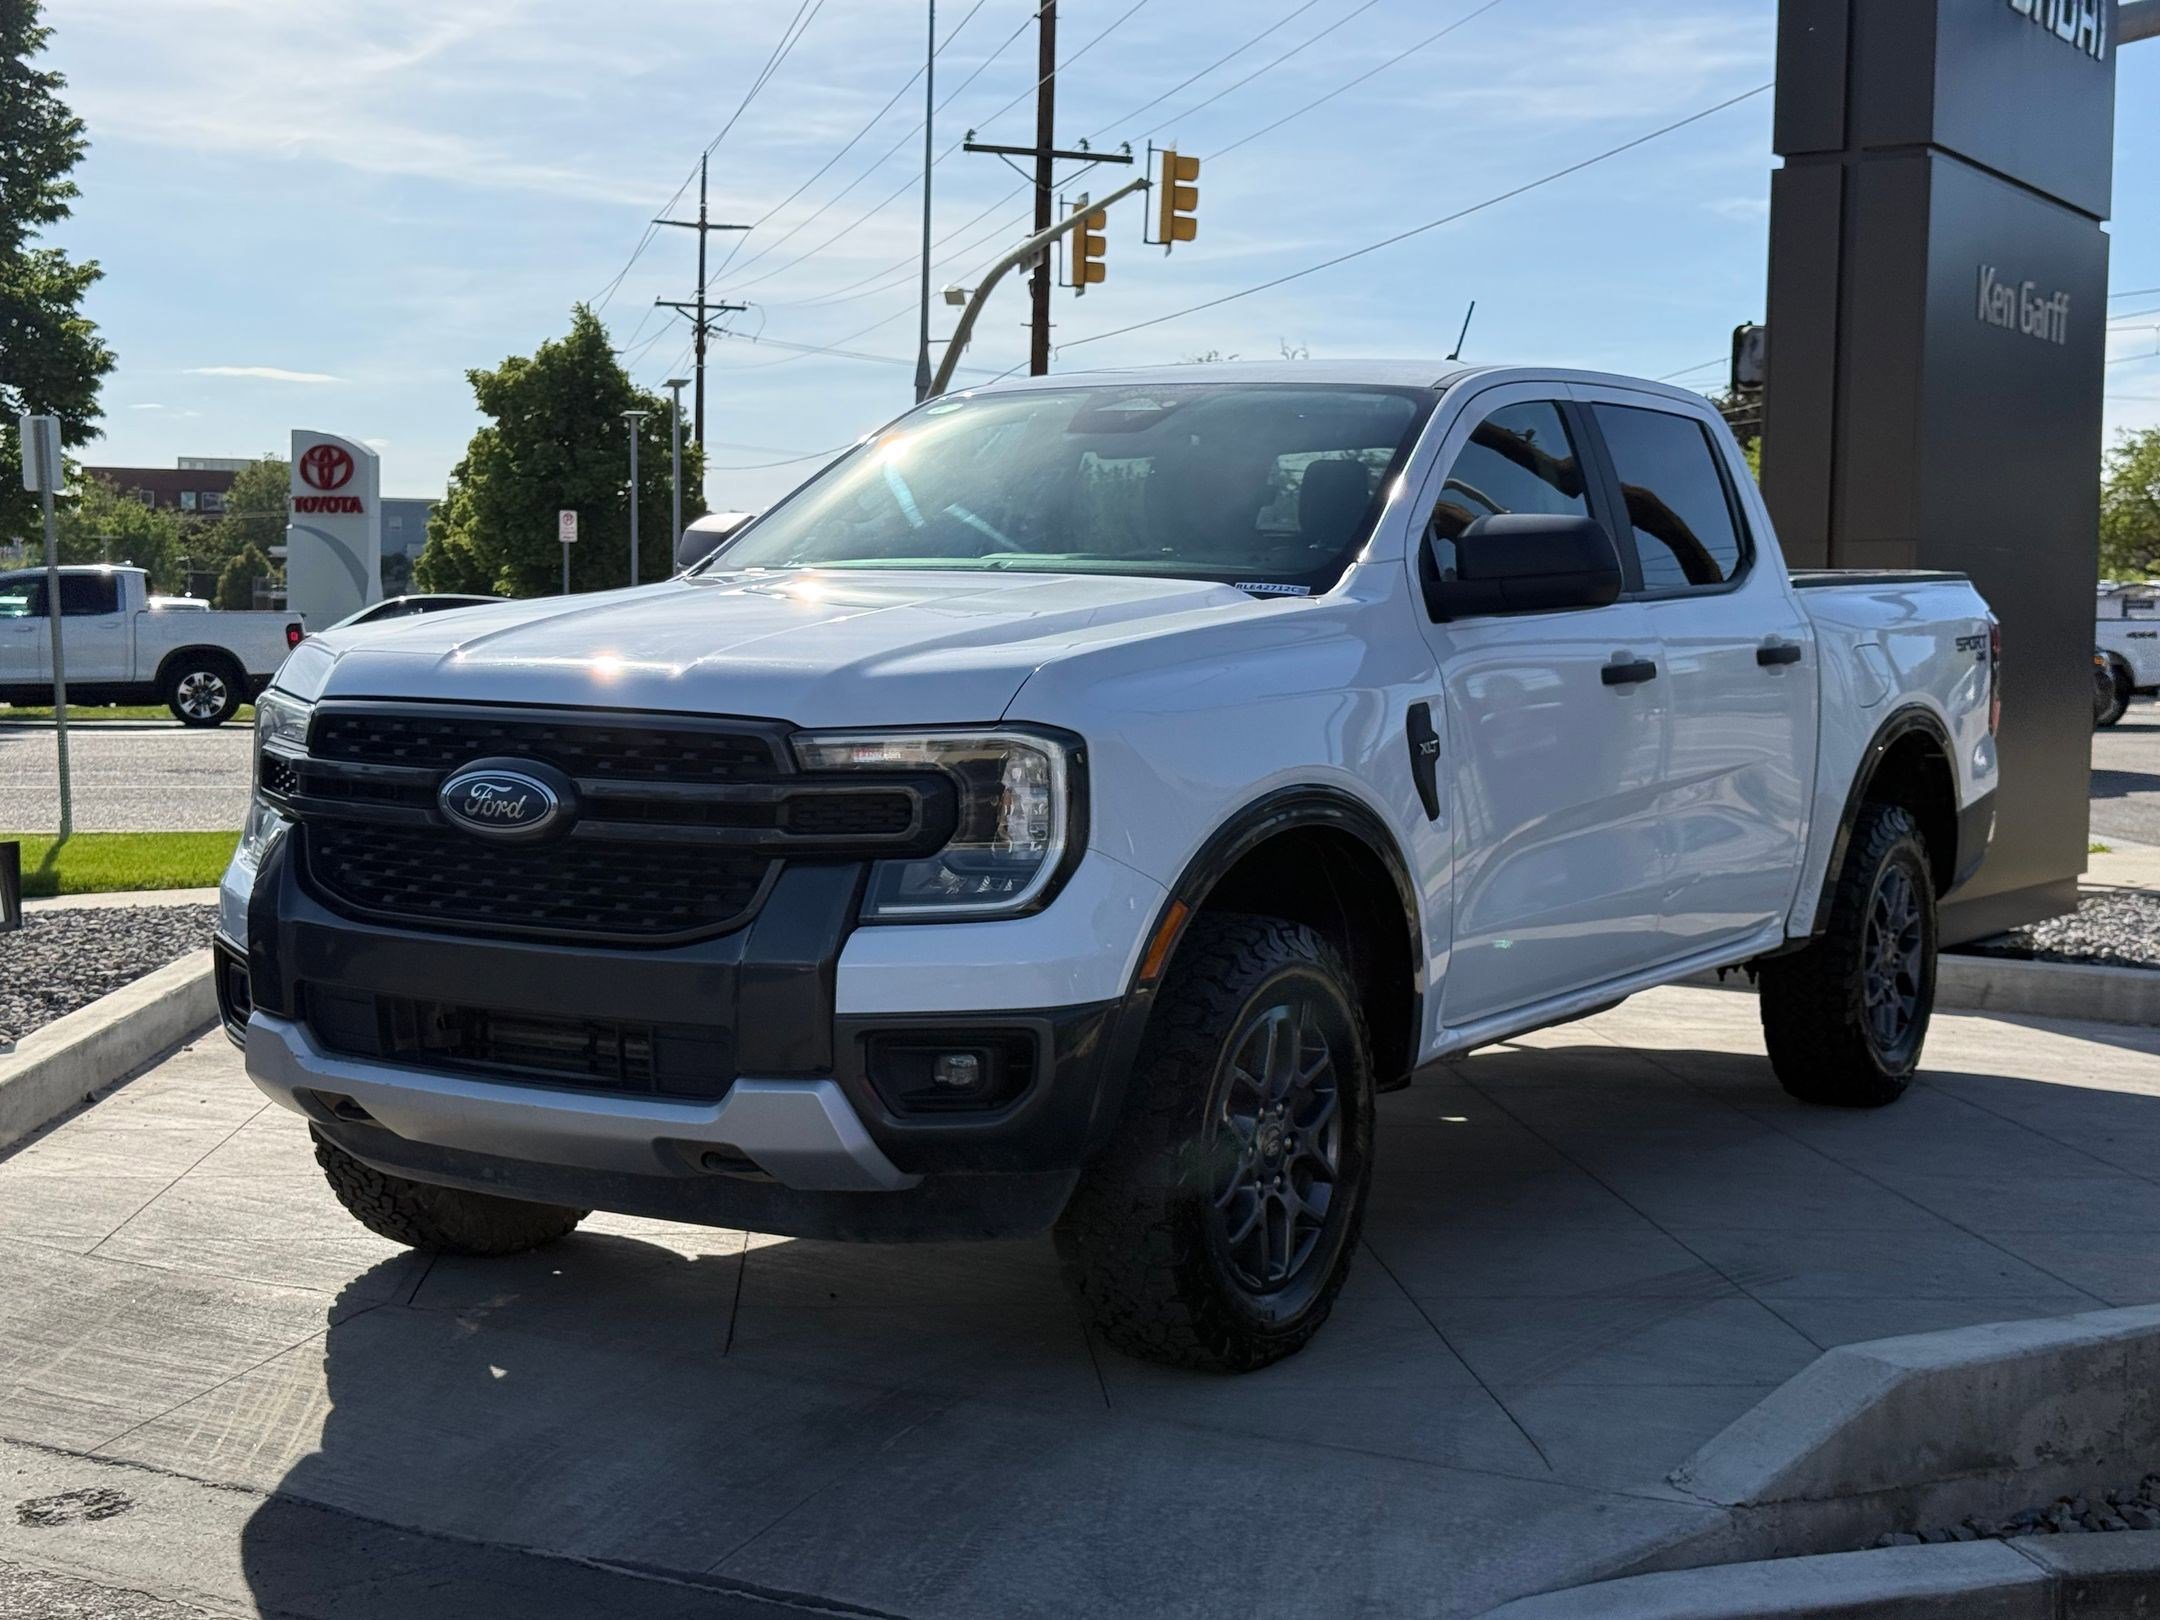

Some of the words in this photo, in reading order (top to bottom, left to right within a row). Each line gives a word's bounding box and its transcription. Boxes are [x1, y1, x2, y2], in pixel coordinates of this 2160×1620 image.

[1978, 264, 2015, 329] Ken
[2021, 281, 2069, 345] Garff
[291, 496, 364, 513] TOYOTA
[1419, 739, 1438, 756] XLT
[463, 782, 528, 819] Ford
